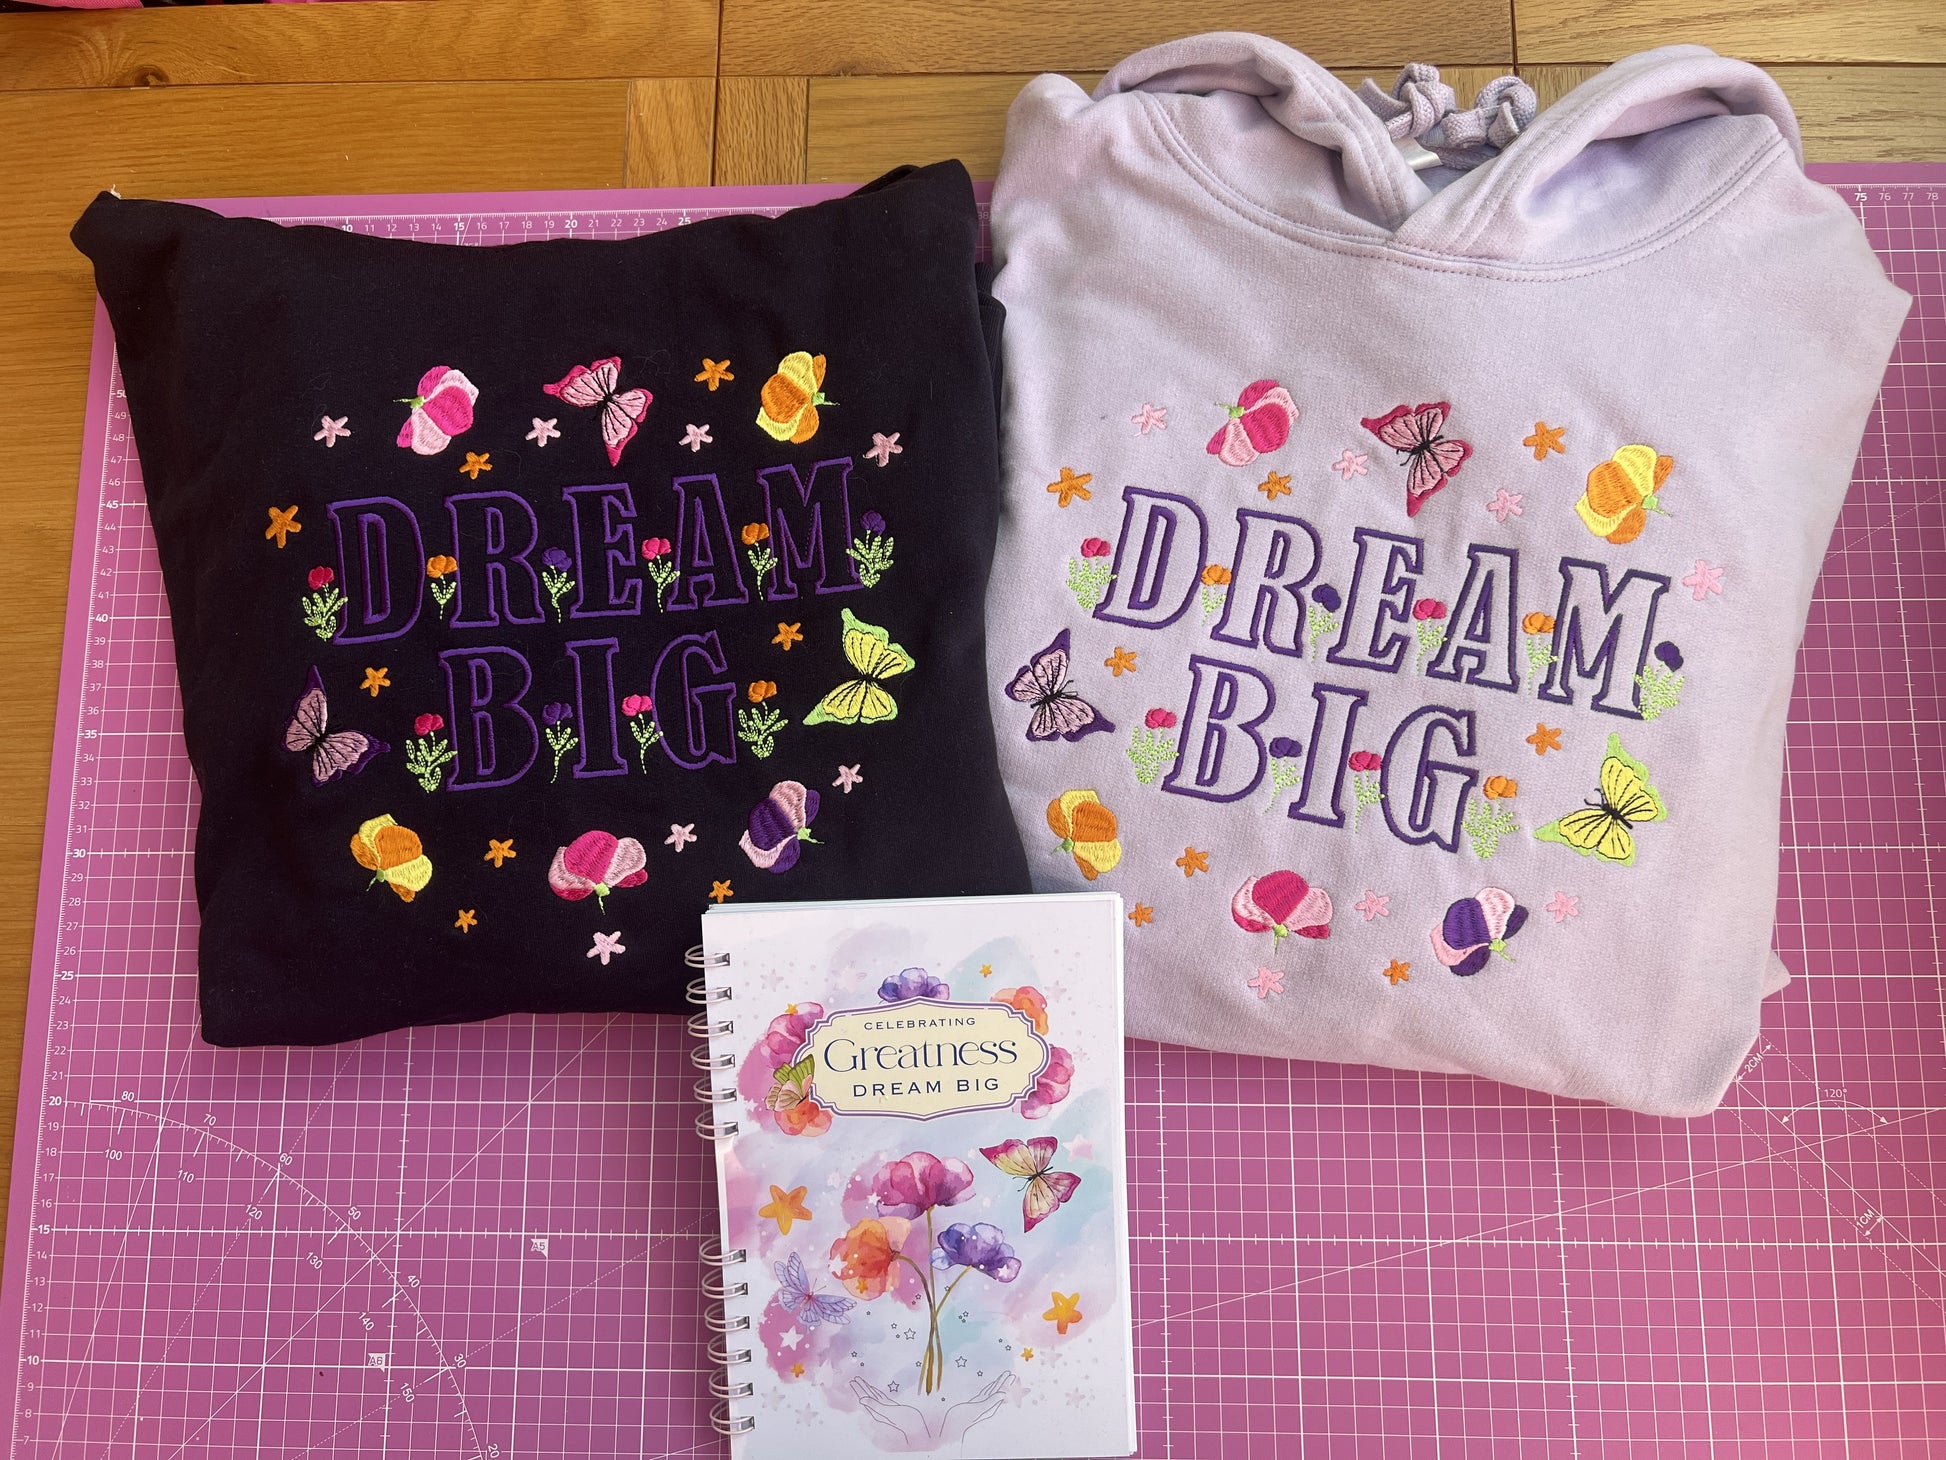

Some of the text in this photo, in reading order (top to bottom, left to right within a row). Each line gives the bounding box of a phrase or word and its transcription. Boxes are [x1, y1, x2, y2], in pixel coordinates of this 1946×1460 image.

[1855, 193, 1939, 201] 75 76 77 78
[341, 224, 353, 233] 10
[365, 223, 375, 232] 11
[386, 223, 397, 232] 12
[408, 222, 420, 232] 13
[431, 222, 442, 231] 14
[453, 222, 465, 231] 15
[476, 222, 488, 231] 16
[499, 221, 510, 230] 17
[521, 220, 533, 229] 18
[544, 220, 555, 229] 19
[564, 219, 578, 229] 20
[588, 218, 600, 227] 21
[610, 218, 623, 227] 22
[633, 218, 646, 227] 23
[656, 218, 668, 227] 24
[678, 217, 691, 226] 25
[114, 412, 127, 420] 49
[112, 433, 125, 442] 48
[110, 456, 122, 464] 47
[108, 478, 120, 486] 46
[106, 500, 119, 509] 45
[104, 523, 116, 531] 44
[102, 545, 114, 554] 43
[326, 456, 866, 646] DREAM
[100, 568, 112, 577] 42
[98, 591, 109, 599] 41
[1093, 486, 1671, 720] DREAM
[95, 613, 108, 622] 40
[93, 637, 106, 645] 39
[91, 660, 104, 668] 38
[89, 683, 101, 692] 37
[87, 706, 99, 715] 36
[438, 630, 736, 792] BIG
[85, 730, 97, 739] 35
[82, 754, 94, 762] 34
[1161, 654, 1479, 853] BIG
[81, 777, 92, 786] 33
[78, 801, 90, 809] 32
[76, 825, 87, 833] 31
[73, 849, 86, 858] 30
[71, 873, 83, 881] 29
[69, 898, 81, 906] 28
[66, 922, 78, 931] 27
[64, 947, 76, 955] 26
[61, 971, 74, 980] 25
[59, 996, 71, 1005] 24
[57, 1021, 69, 1030] 23
[864, 1017, 976, 1031] CELEBRATING
[54, 1046, 66, 1055] 22
[824, 1038, 1018, 1072] Greatness
[1744, 1053, 1764, 1073] 2CM
[52, 1071, 63, 1080] 21
[853, 1077, 999, 1097] DREAM BIG
[49, 1097, 62, 1105] 20
[121, 1090, 135, 1103] 80
[203, 1113, 217, 1126] 70
[47, 1122, 59, 1130] 19
[45, 1147, 57, 1157] 18
[104, 1149, 123, 1161] 100
[279, 1152, 293, 1167] 60
[43, 1173, 55, 1182] 17
[177, 1170, 195, 1184] 110
[41, 1199, 52, 1208] 16
[245, 1204, 263, 1221] 120
[347, 1206, 362, 1221] 50
[1856, 1209, 1875, 1228] 1CM
[38, 1224, 50, 1234] 15
[531, 1241, 546, 1251] A5
[36, 1250, 47, 1260] 14
[306, 1252, 323, 1270] 130
[33, 1277, 45, 1286] 13
[407, 1274, 420, 1289] 40
[31, 1303, 43, 1312] 12
[357, 1312, 375, 1331] 140
[29, 1329, 40, 1338] 11
[27, 1355, 39, 1365] 10
[369, 1356, 384, 1365] A6
[453, 1353, 467, 1368] 30
[27, 1381, 33, 1391] 9
[400, 1382, 415, 1402] 150
[25, 1408, 31, 1418] 8
[23, 1435, 29, 1445] 7
[487, 1444, 499, 1459] 20
